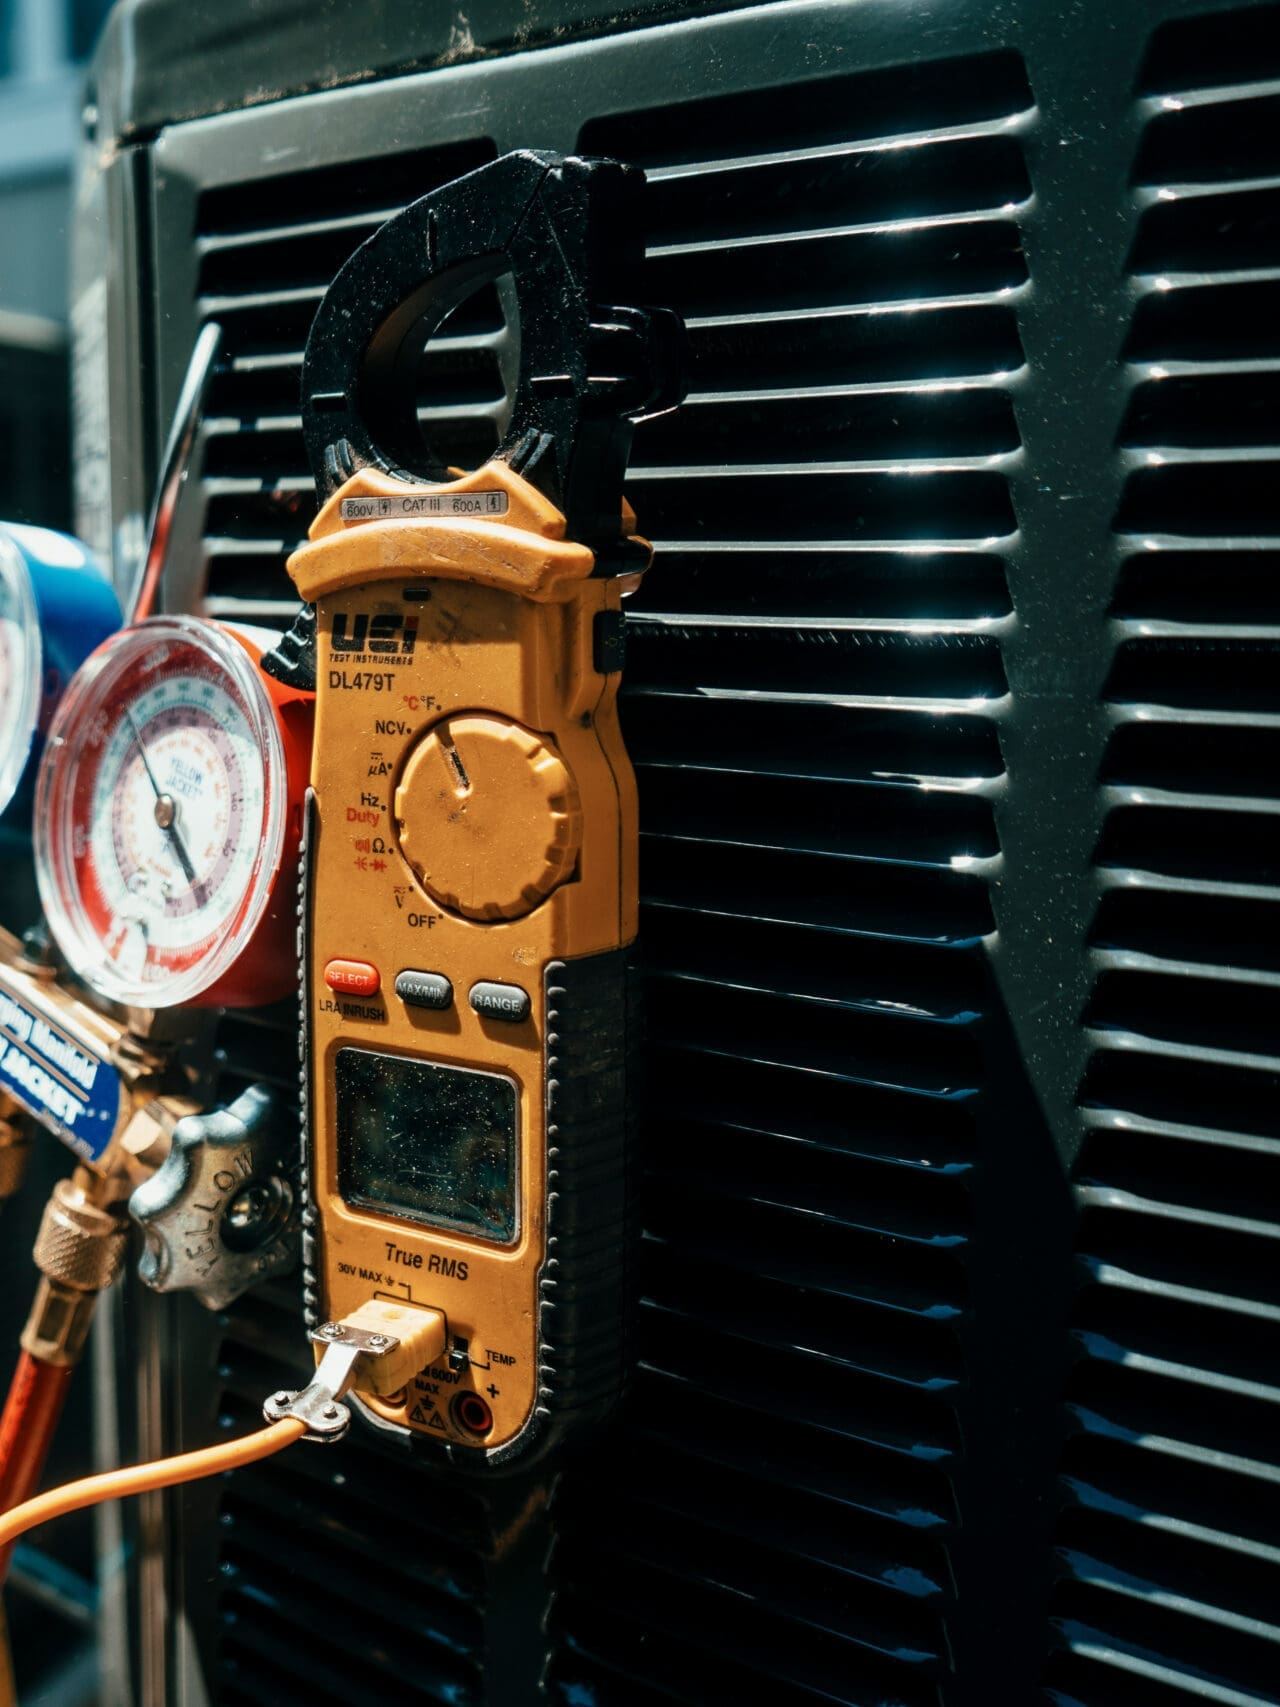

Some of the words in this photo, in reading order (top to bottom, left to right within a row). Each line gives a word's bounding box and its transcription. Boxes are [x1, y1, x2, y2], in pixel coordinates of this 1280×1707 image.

[347, 504, 374, 517] 600V
[402, 498, 426, 513] CAT
[452, 500, 482, 513] 600A
[329, 653, 351, 663] TEST
[352, 654, 414, 666] INSTRUMENTS
[328, 670, 396, 692] DL479T
[375, 720, 406, 736] NCV
[361, 792, 380, 807] Hz
[346, 807, 380, 829] Duty
[407, 912, 437, 929] OFF
[328, 971, 370, 986] SELECT
[473, 994, 521, 1013] RANGE
[385, 1242, 423, 1269] True
[428, 1254, 470, 1281] RMS
[337, 1262, 357, 1276] 30V
[359, 1268, 383, 1284] MAX
[485, 1349, 517, 1367] TEMP
[415, 1379, 440, 1395] MAX
